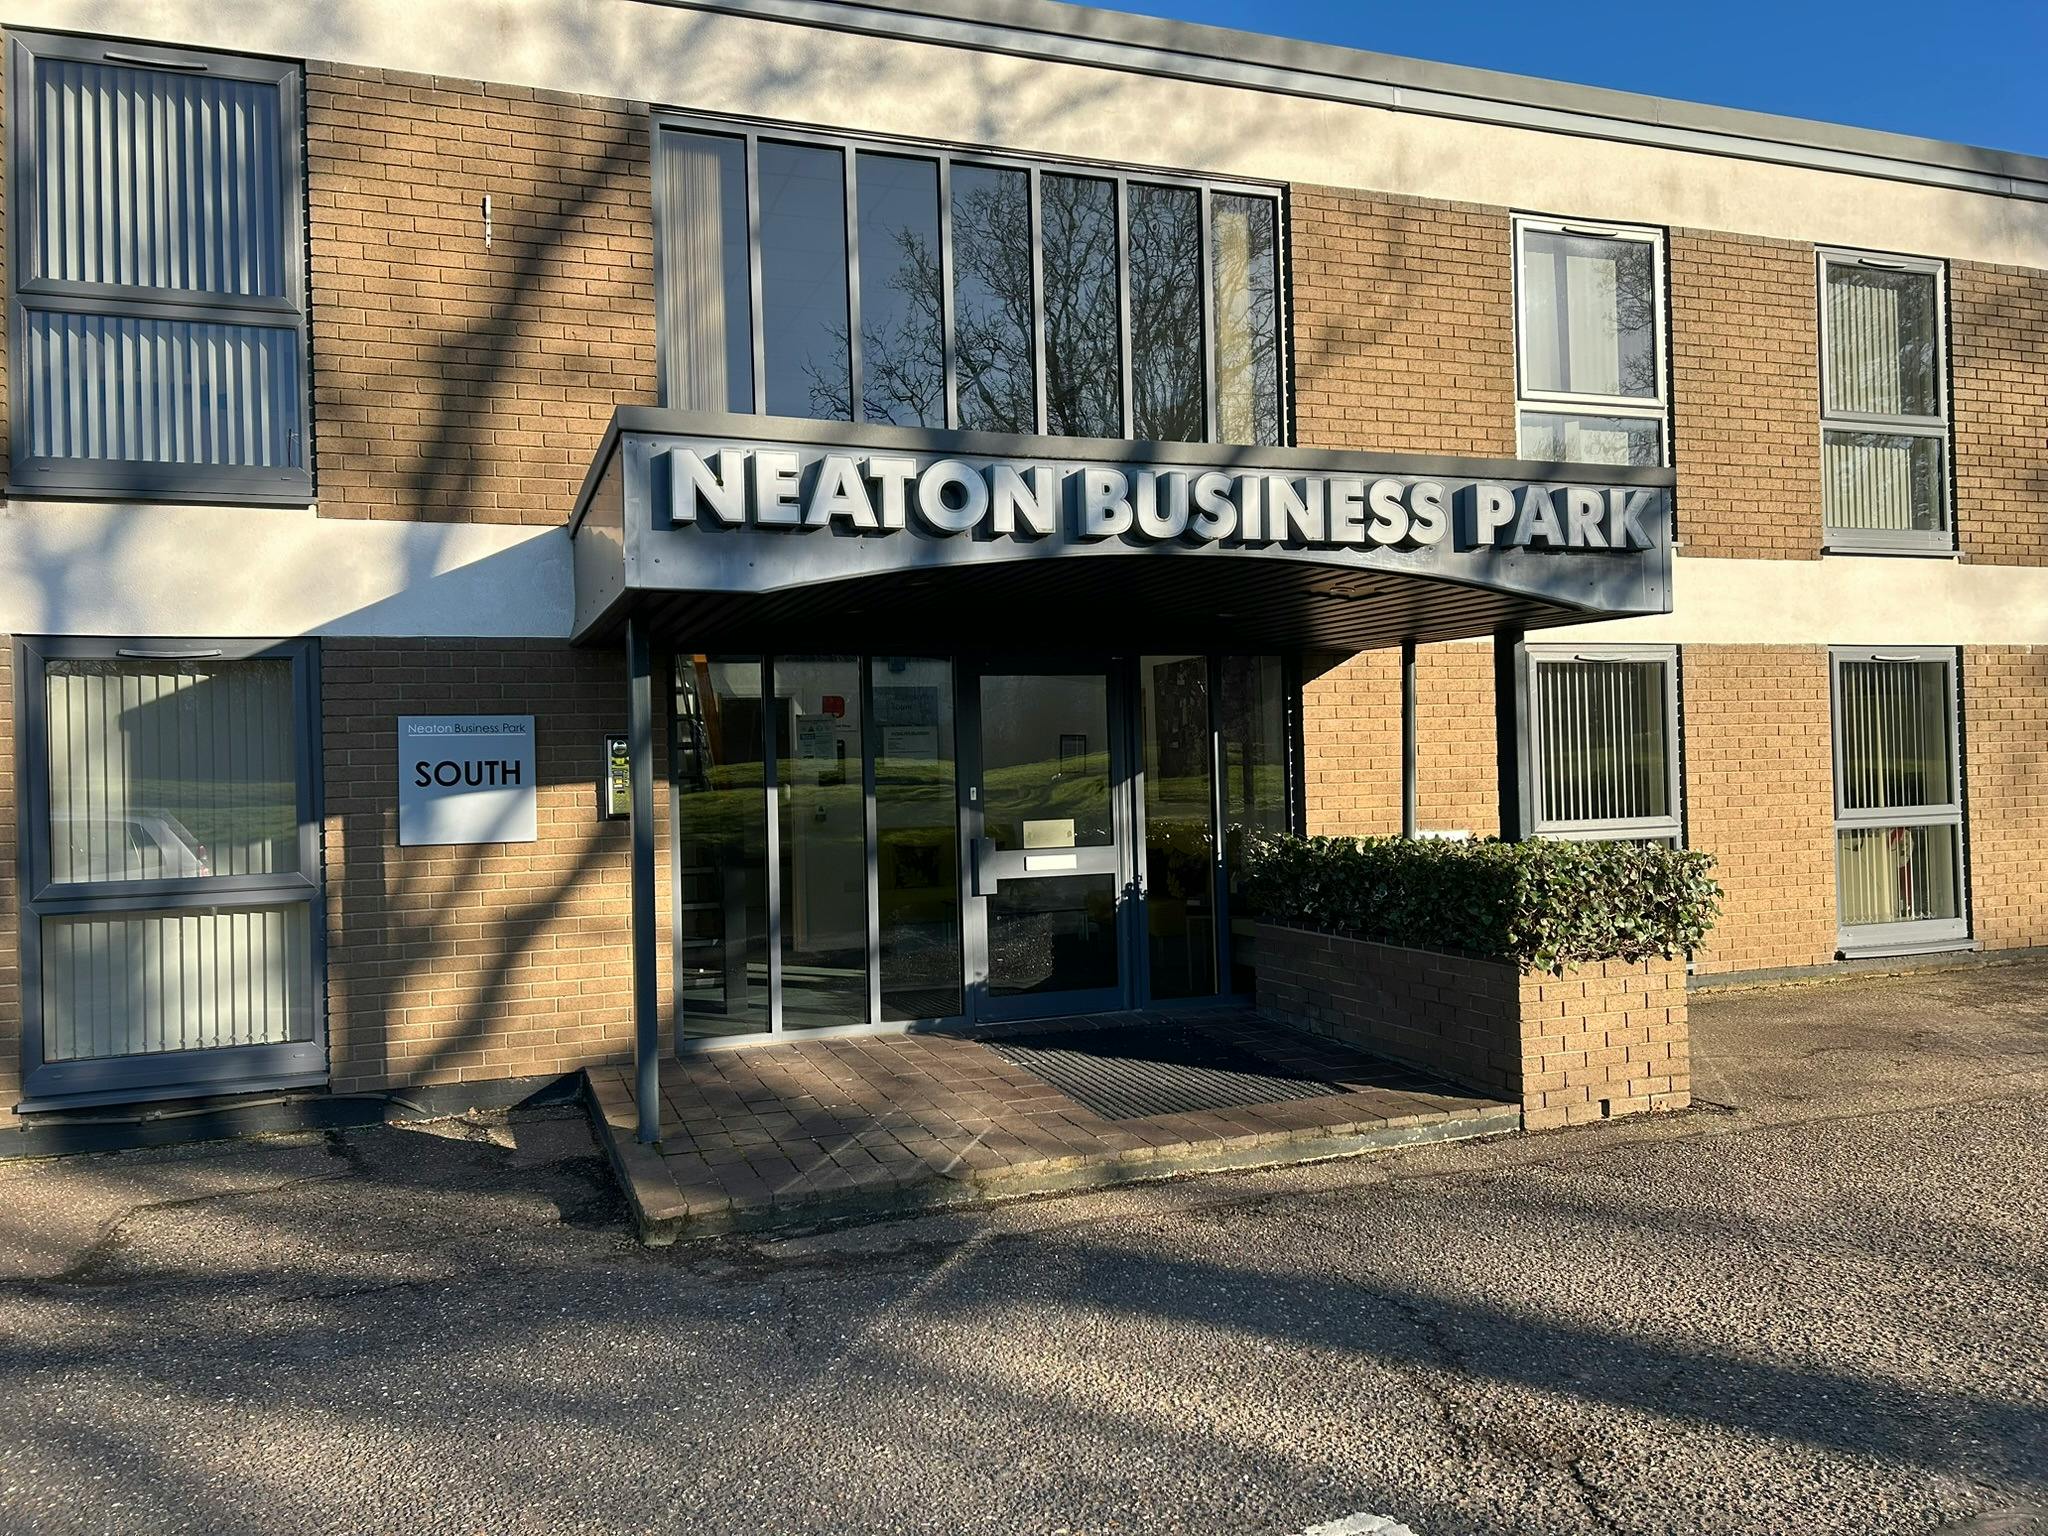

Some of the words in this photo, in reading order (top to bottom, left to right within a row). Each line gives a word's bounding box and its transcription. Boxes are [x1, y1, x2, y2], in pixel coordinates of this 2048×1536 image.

[670, 446, 1056, 534] NEATON
[1083, 467, 1450, 546] BUSINESS
[1470, 483, 1656, 550] PARK
[408, 723, 453, 734] Neaton
[454, 723, 500, 734] Business
[502, 722, 526, 733] Park
[414, 760, 521, 787] SOUTH
